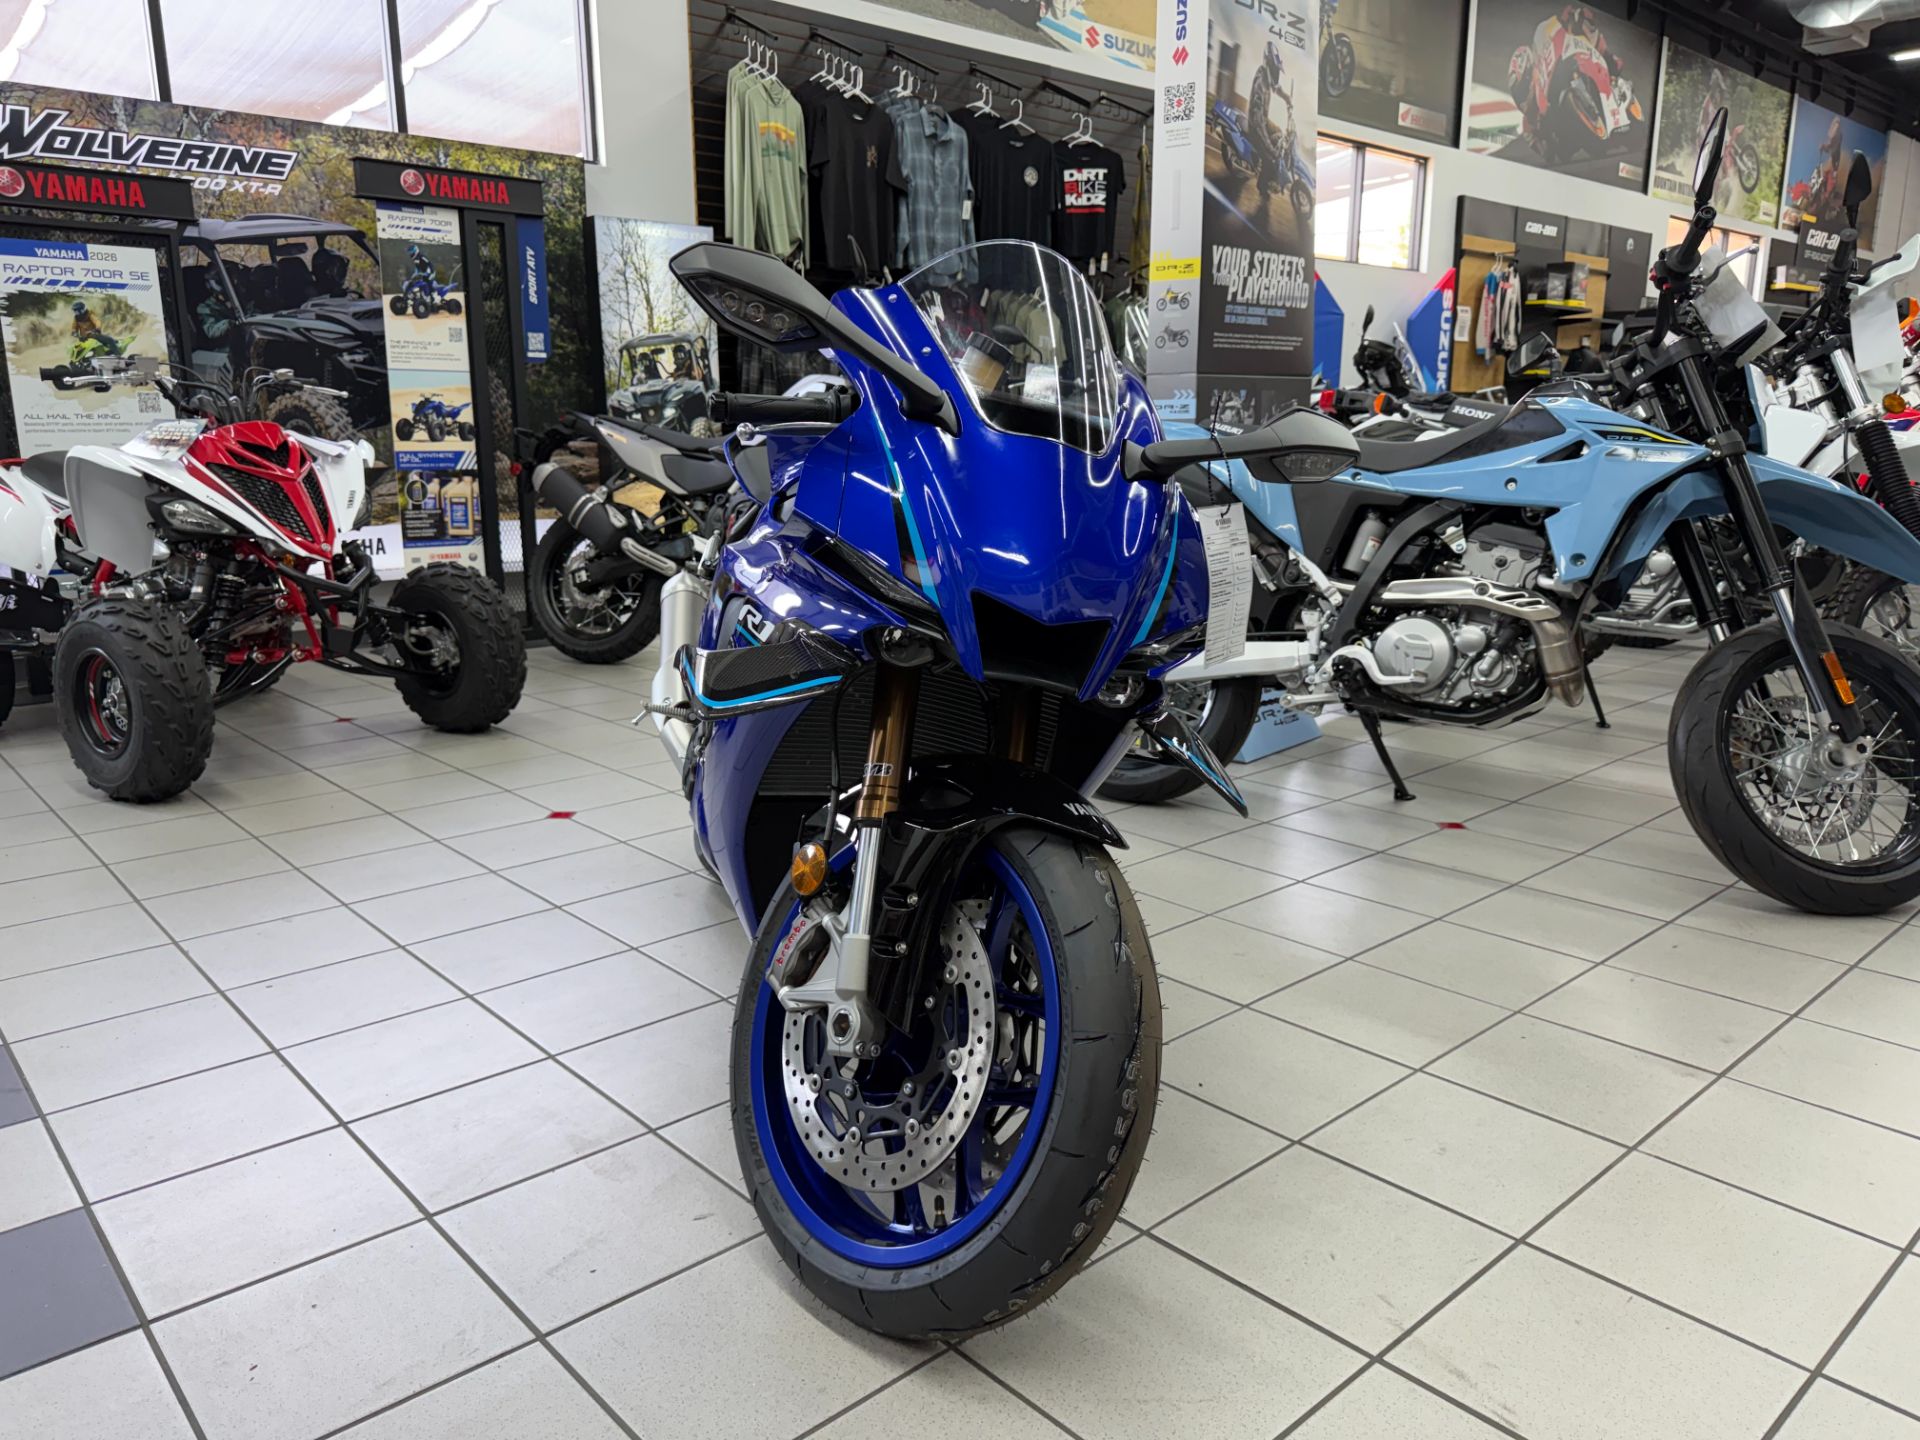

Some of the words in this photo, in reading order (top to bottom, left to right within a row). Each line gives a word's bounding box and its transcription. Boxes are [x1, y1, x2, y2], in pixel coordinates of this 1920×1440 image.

[1175, 0, 1188, 41] SUZ
[1103, 33, 1156, 60] SUZUK
[0, 104, 300, 181] WOLVERINE
[26, 170, 146, 209] YAMAHA
[426, 172, 511, 205] YAMAHA
[1064, 180, 1109, 195] BIKE
[387, 214, 426, 225] RAPTOR
[34, 247, 85, 260] YAMAHA
[525, 246, 536, 272] ATV
[1211, 244, 1251, 278] YOUR
[1253, 250, 1306, 283] STREETS
[3, 263, 75, 277] RAPTOR
[80, 267, 124, 281] 700R
[128, 271, 151, 282] SE
[528, 269, 538, 305] SPORT
[1212, 272, 1231, 287] YOUR
[1226, 275, 1311, 309] PLAYGROUND
[1435, 288, 1454, 393] SUZUK
[774, 918, 807, 967] brembo
